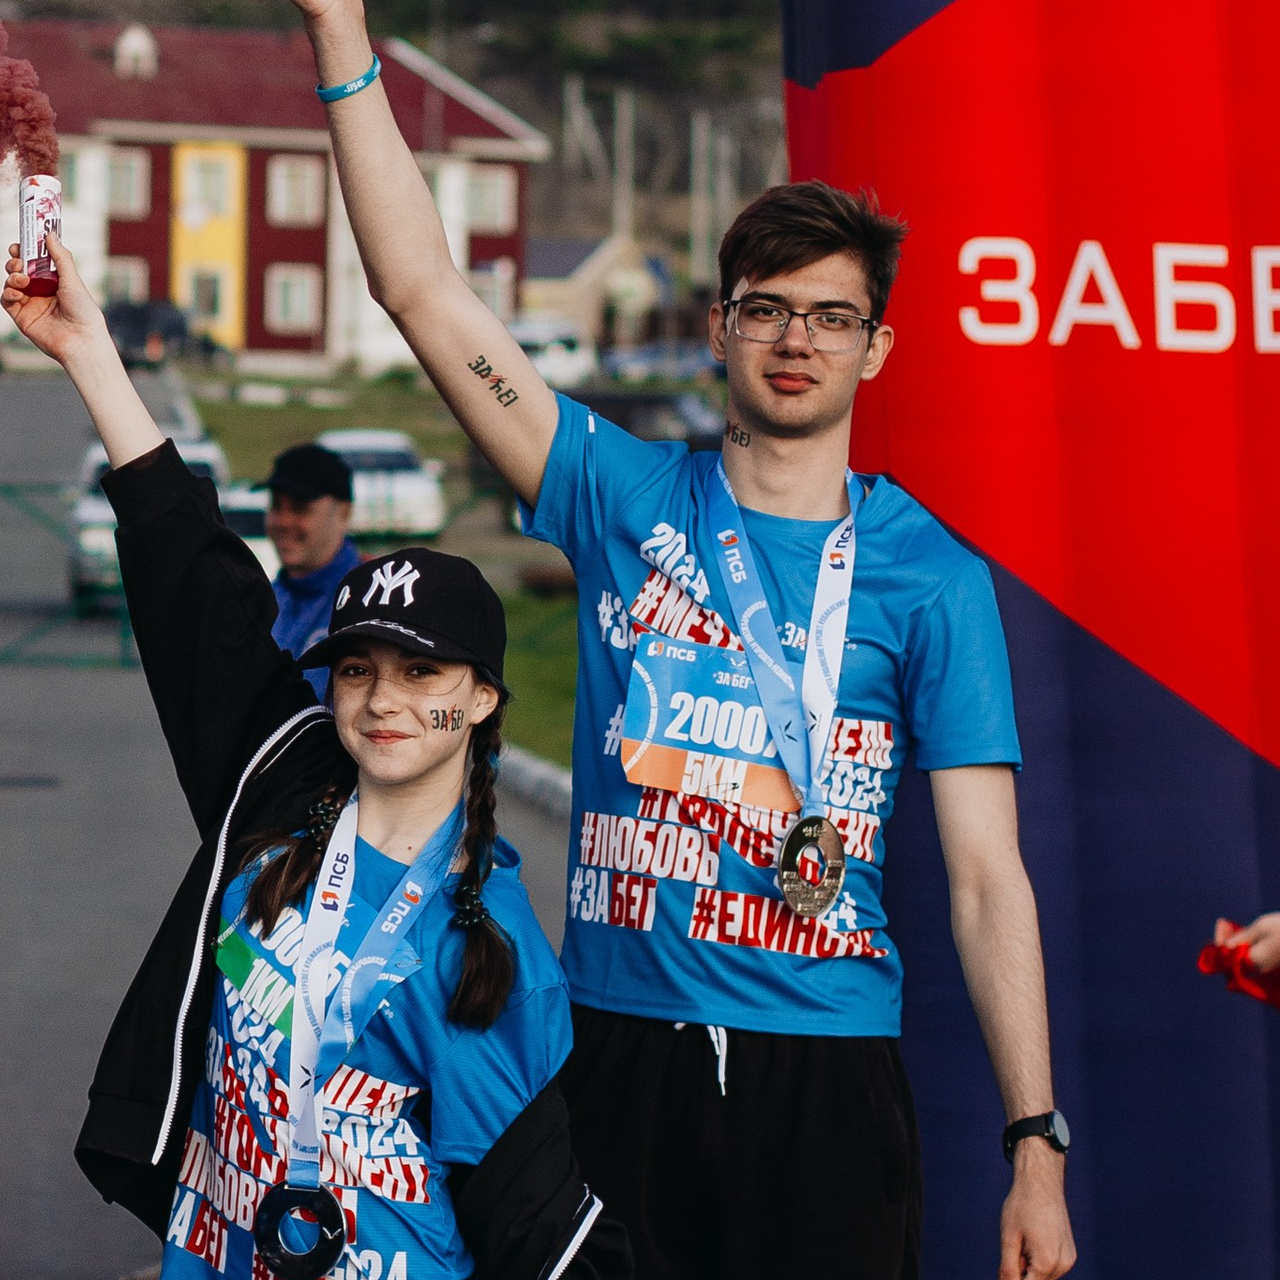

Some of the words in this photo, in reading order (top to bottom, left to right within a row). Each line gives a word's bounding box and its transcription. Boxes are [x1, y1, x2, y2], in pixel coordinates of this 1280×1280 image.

[640, 522, 710, 604] 2024
[724, 548, 747, 584] ПСБ
[666, 646, 697, 662] ПСБ
[580, 812, 720, 887] #ЛЮБОВЬ
[328, 852, 350, 888] ПСБ
[381, 901, 411, 934] ПСБ
[570, 867, 658, 932] #ЗАБЕГ
